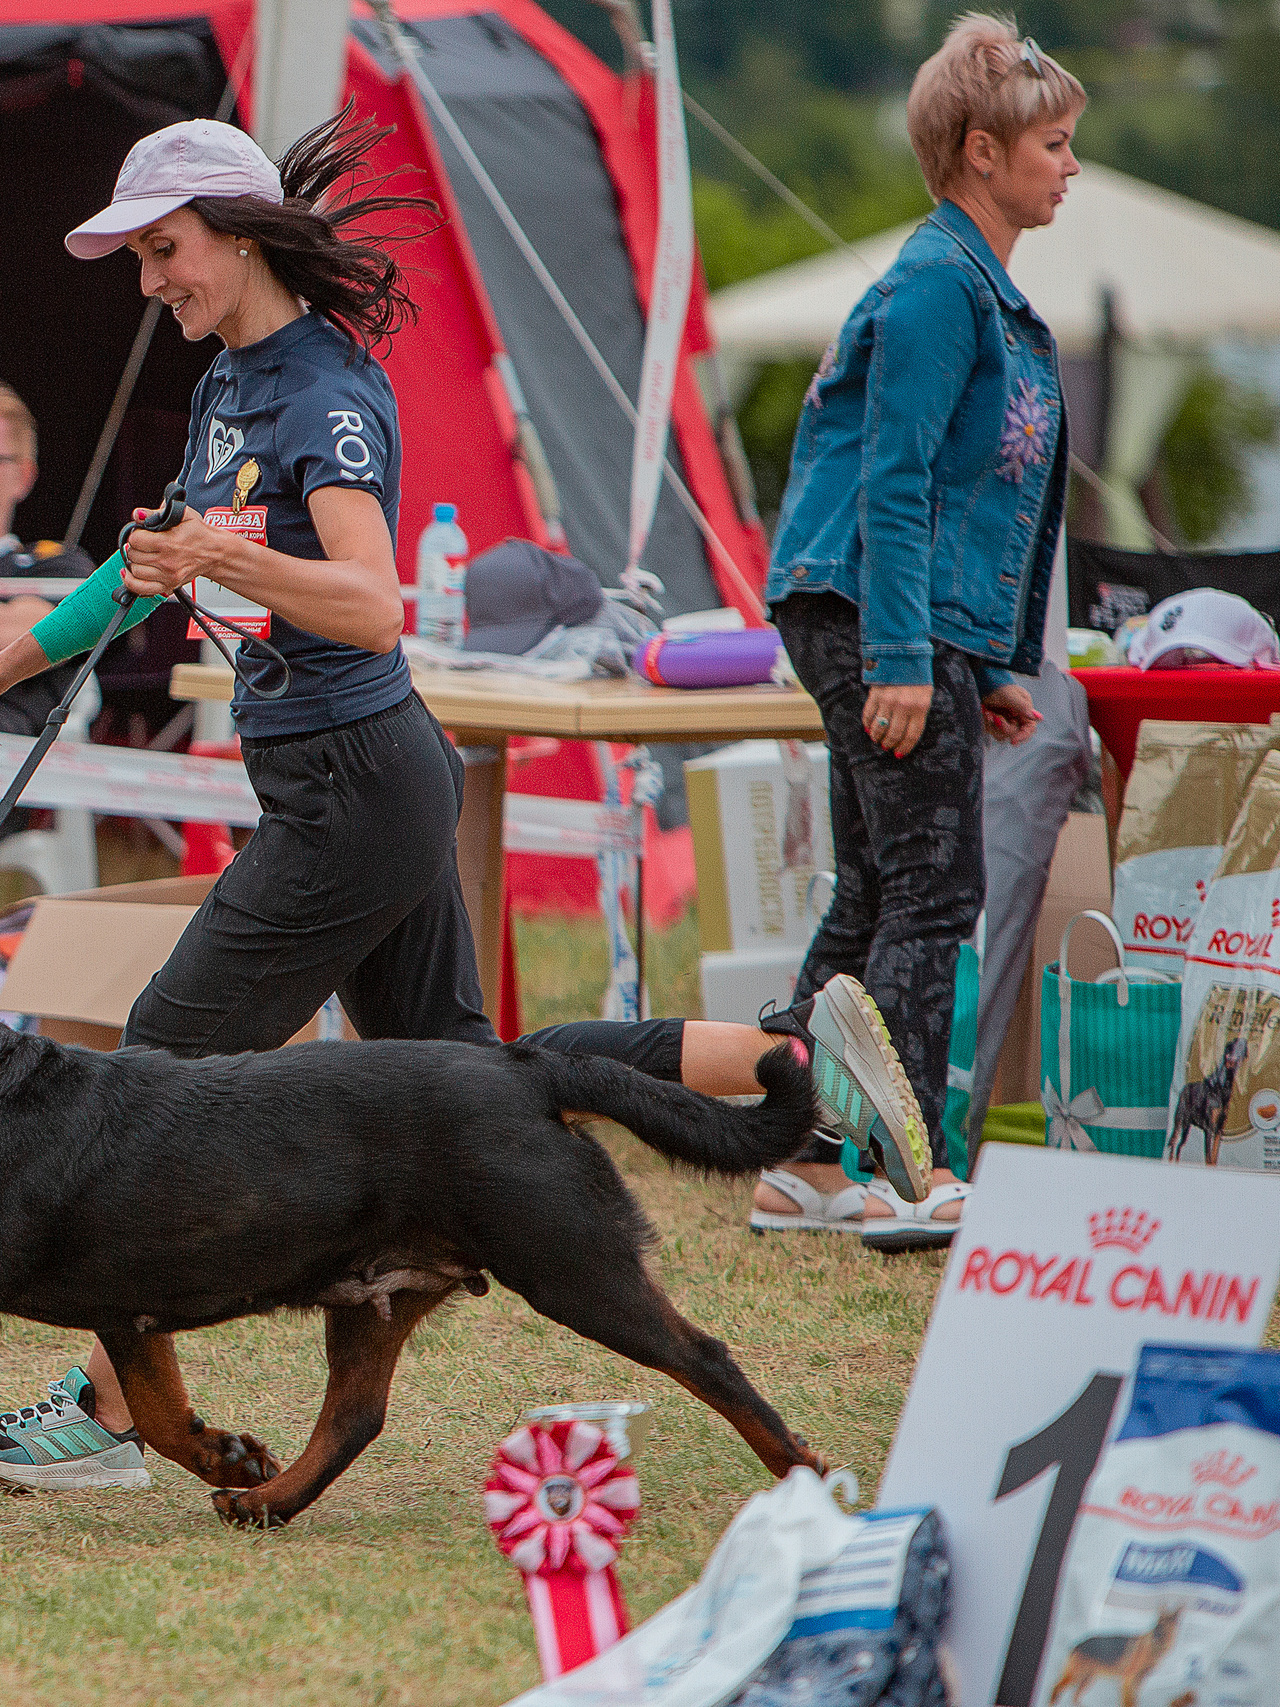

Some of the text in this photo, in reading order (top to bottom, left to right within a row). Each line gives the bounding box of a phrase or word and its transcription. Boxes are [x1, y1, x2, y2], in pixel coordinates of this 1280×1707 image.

[205, 513, 262, 528] ТРАПЕЗА
[959, 1246, 1263, 1325] ROYAL CANIN
[1119, 1487, 1195, 1517] ROYA
[994, 1373, 1125, 1707] 1
